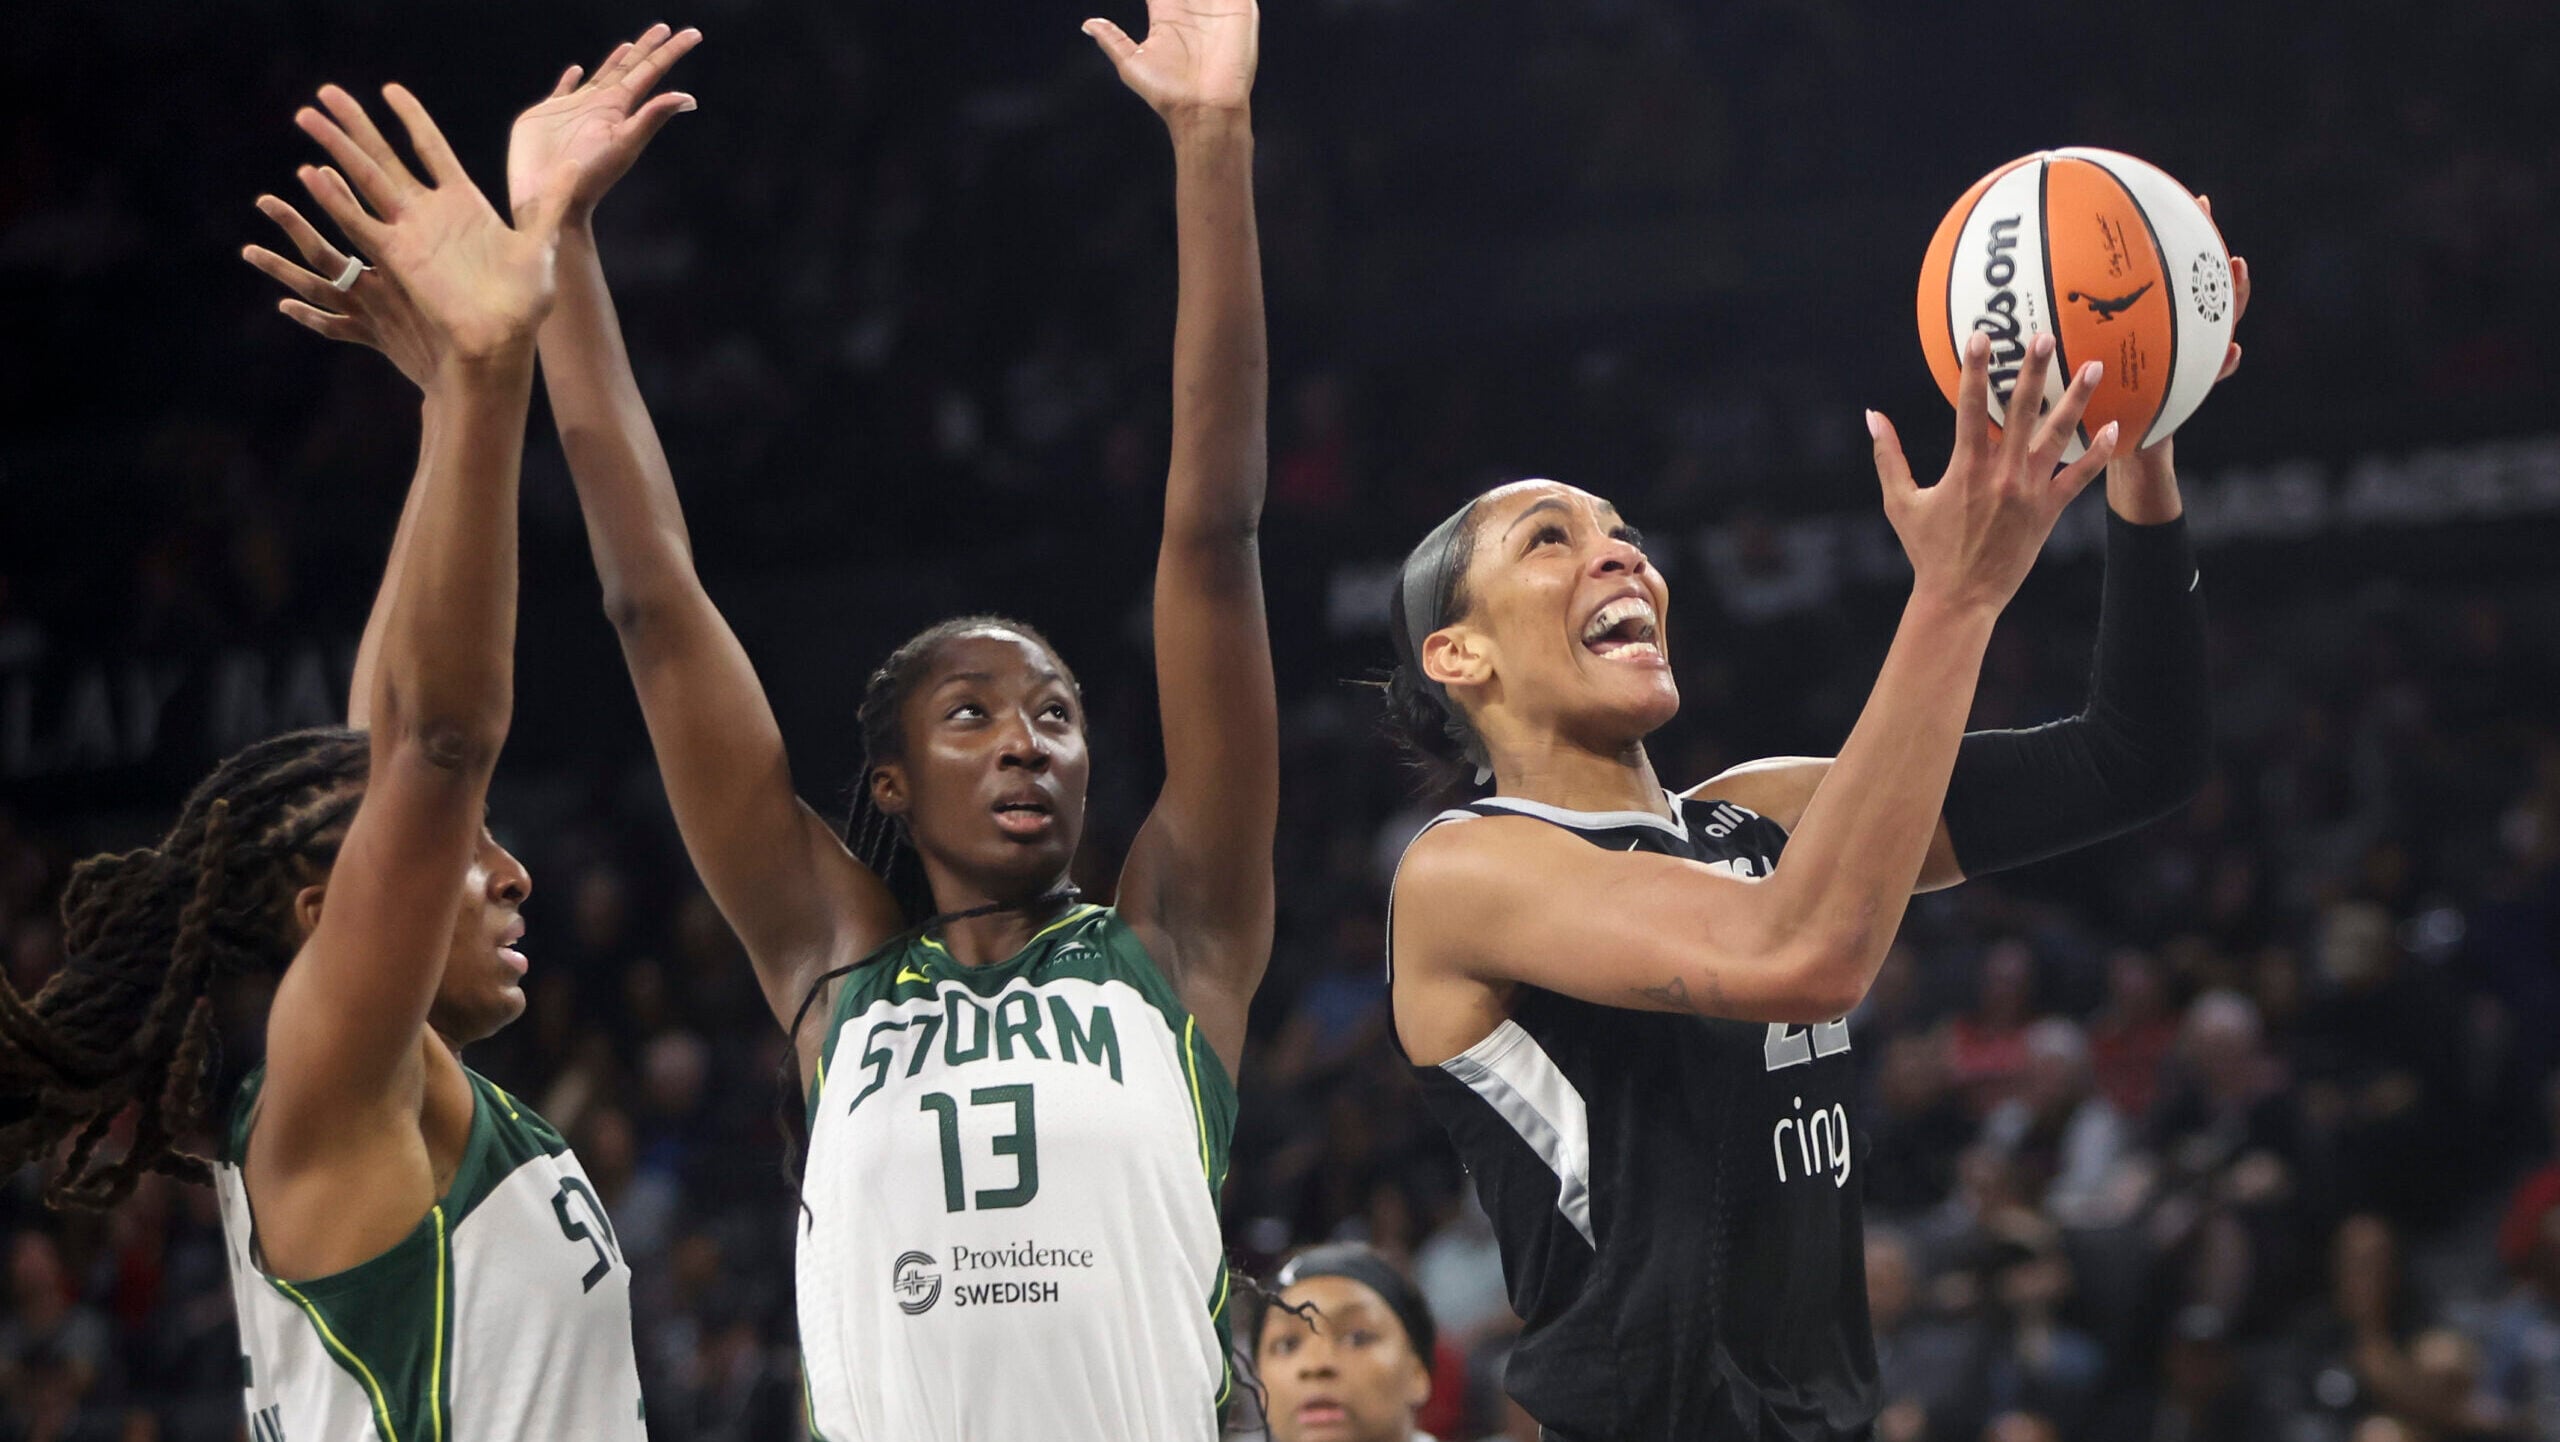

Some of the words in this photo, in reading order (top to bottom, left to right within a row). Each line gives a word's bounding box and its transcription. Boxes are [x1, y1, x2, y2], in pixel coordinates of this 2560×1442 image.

[848, 989, 1124, 1117] STORM
[919, 1082, 1040, 1213] 13
[1773, 1096, 1851, 1189] ring
[951, 1240, 1094, 1272] Providence
[954, 1281, 1059, 1306] SWEDISH
